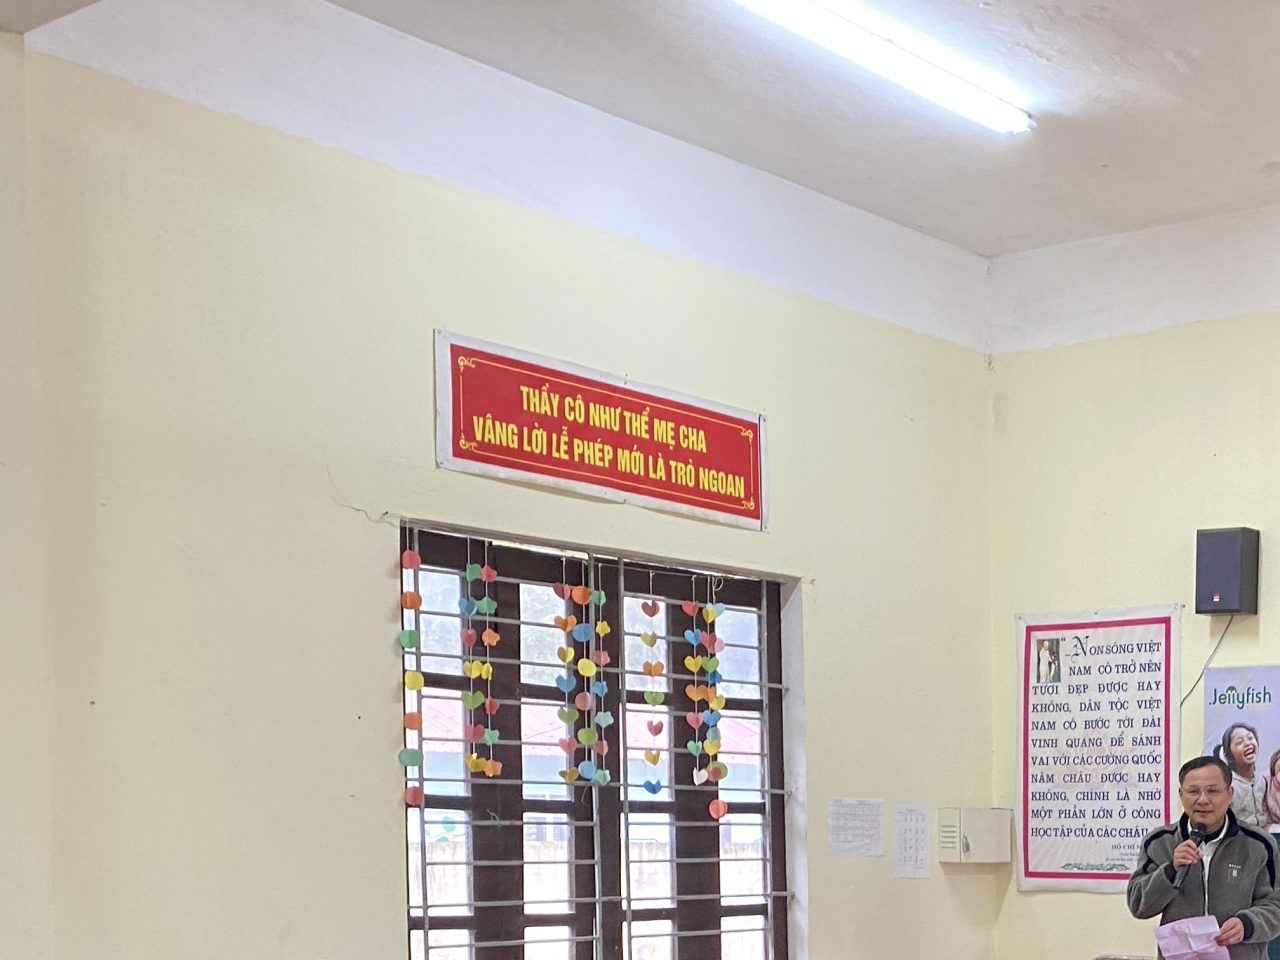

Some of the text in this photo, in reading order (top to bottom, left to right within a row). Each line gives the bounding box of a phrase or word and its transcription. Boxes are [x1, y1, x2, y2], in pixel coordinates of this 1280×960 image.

[520, 383, 707, 453] THẦY CÔ NHƯ THỂ MẸ CHA
[473, 413, 745, 498] VÂNG LỜI LỄ PHÉP MỚI LÀ TRÒ NGOAN
[1136, 640, 1161, 654] VIỆT
[1069, 665, 1091, 676] NAM
[1098, 661, 1112, 675] CÓ
[1115, 659, 1136, 674] TRỞ
[1068, 684, 1088, 696] ĐẸP
[1098, 682, 1128, 695] ĐƯỢC
[1137, 681, 1161, 691] HAY
[1032, 700, 1072, 713] KHÔNG,
[1109, 698, 1129, 712] TỘC
[1137, 697, 1161, 711] VIỆT
[1209, 686, 1271, 710] Jellyfish
[1031, 721, 1056, 730] NAM
[1063, 718, 1077, 730] CÓ
[1084, 716, 1110, 729] BƯỚC
[1117, 716, 1134, 728] TỚI
[1031, 739, 1058, 748] VINH
[1066, 738, 1103, 748] QUANG
[1132, 733, 1161, 746] SÁNH
[1031, 756, 1049, 765] VAI
[1052, 753, 1070, 765] VỚI
[1073, 753, 1093, 765] CÁC
[1132, 750, 1161, 764] QUỐC
[1101, 771, 1128, 784] ĐƯỢC
[1138, 773, 1161, 782] HAY
[1031, 789, 1069, 802] KHÔNG,
[1076, 788, 1109, 800] CHÍNH
[1117, 788, 1130, 800] LÀ
[1031, 806, 1053, 820] MỘT
[1092, 806, 1113, 818] LỚN
[1132, 806, 1161, 818] CÔNG
[1031, 828, 1052, 839] HỌC
[1053, 825, 1072, 840] TẬP
[1074, 824, 1094, 837] CỦA
[1097, 825, 1117, 837] CÁC
